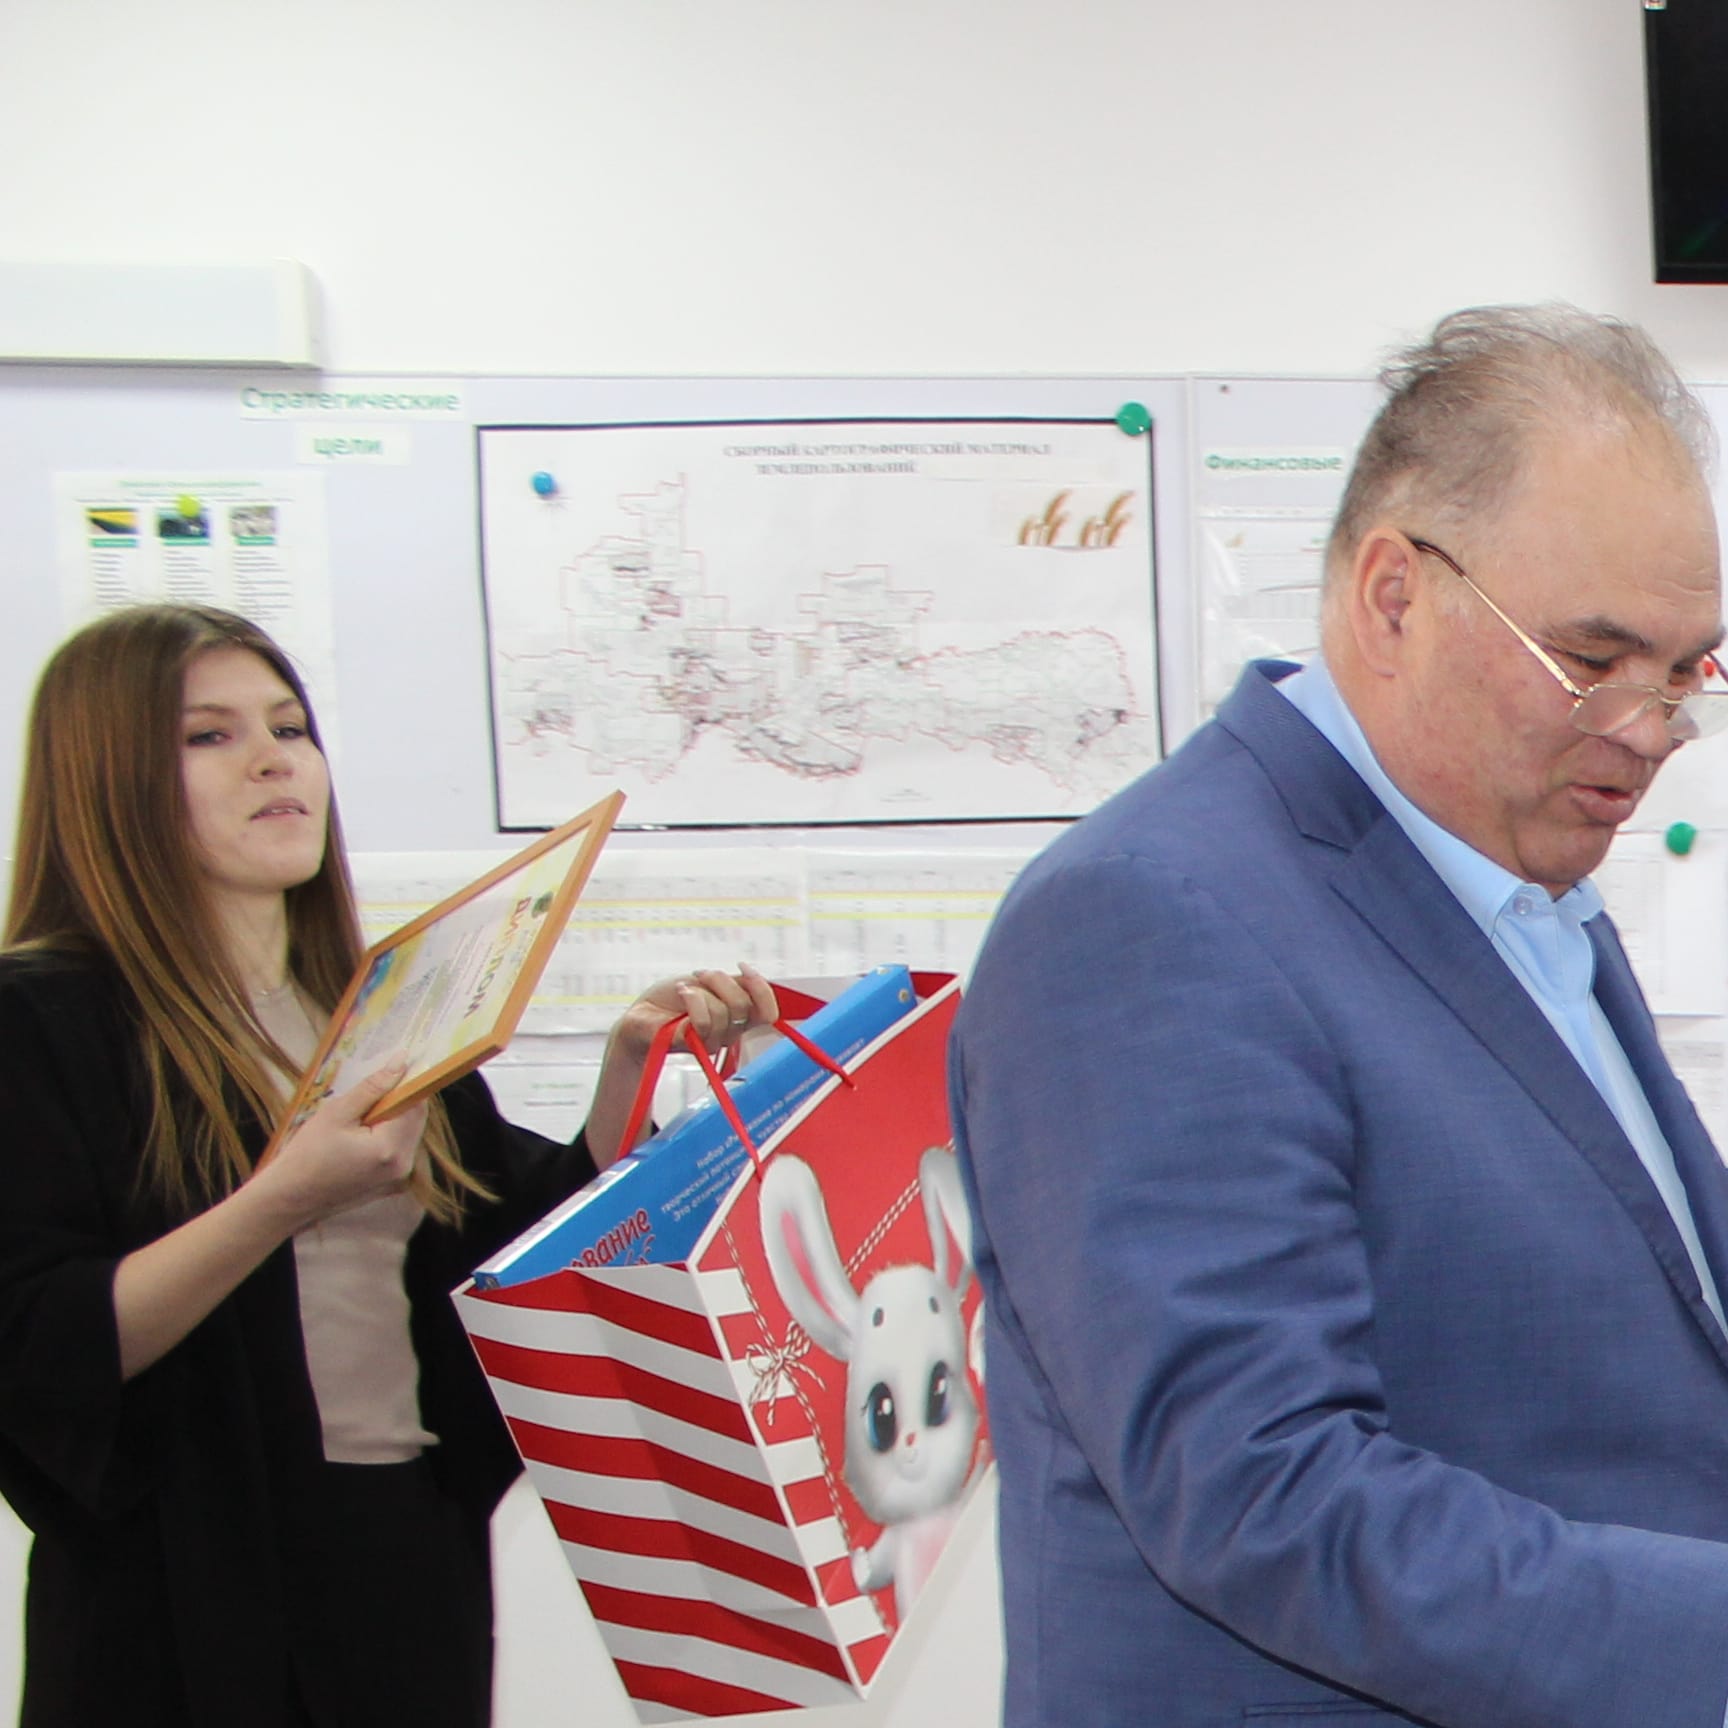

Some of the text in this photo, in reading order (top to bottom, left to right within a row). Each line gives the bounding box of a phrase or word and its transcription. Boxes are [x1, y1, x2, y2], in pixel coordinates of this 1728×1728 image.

[241, 386, 461, 412] Стратегические
[313, 437, 384, 458] цели
[1204, 453, 1344, 471] Финансовые
